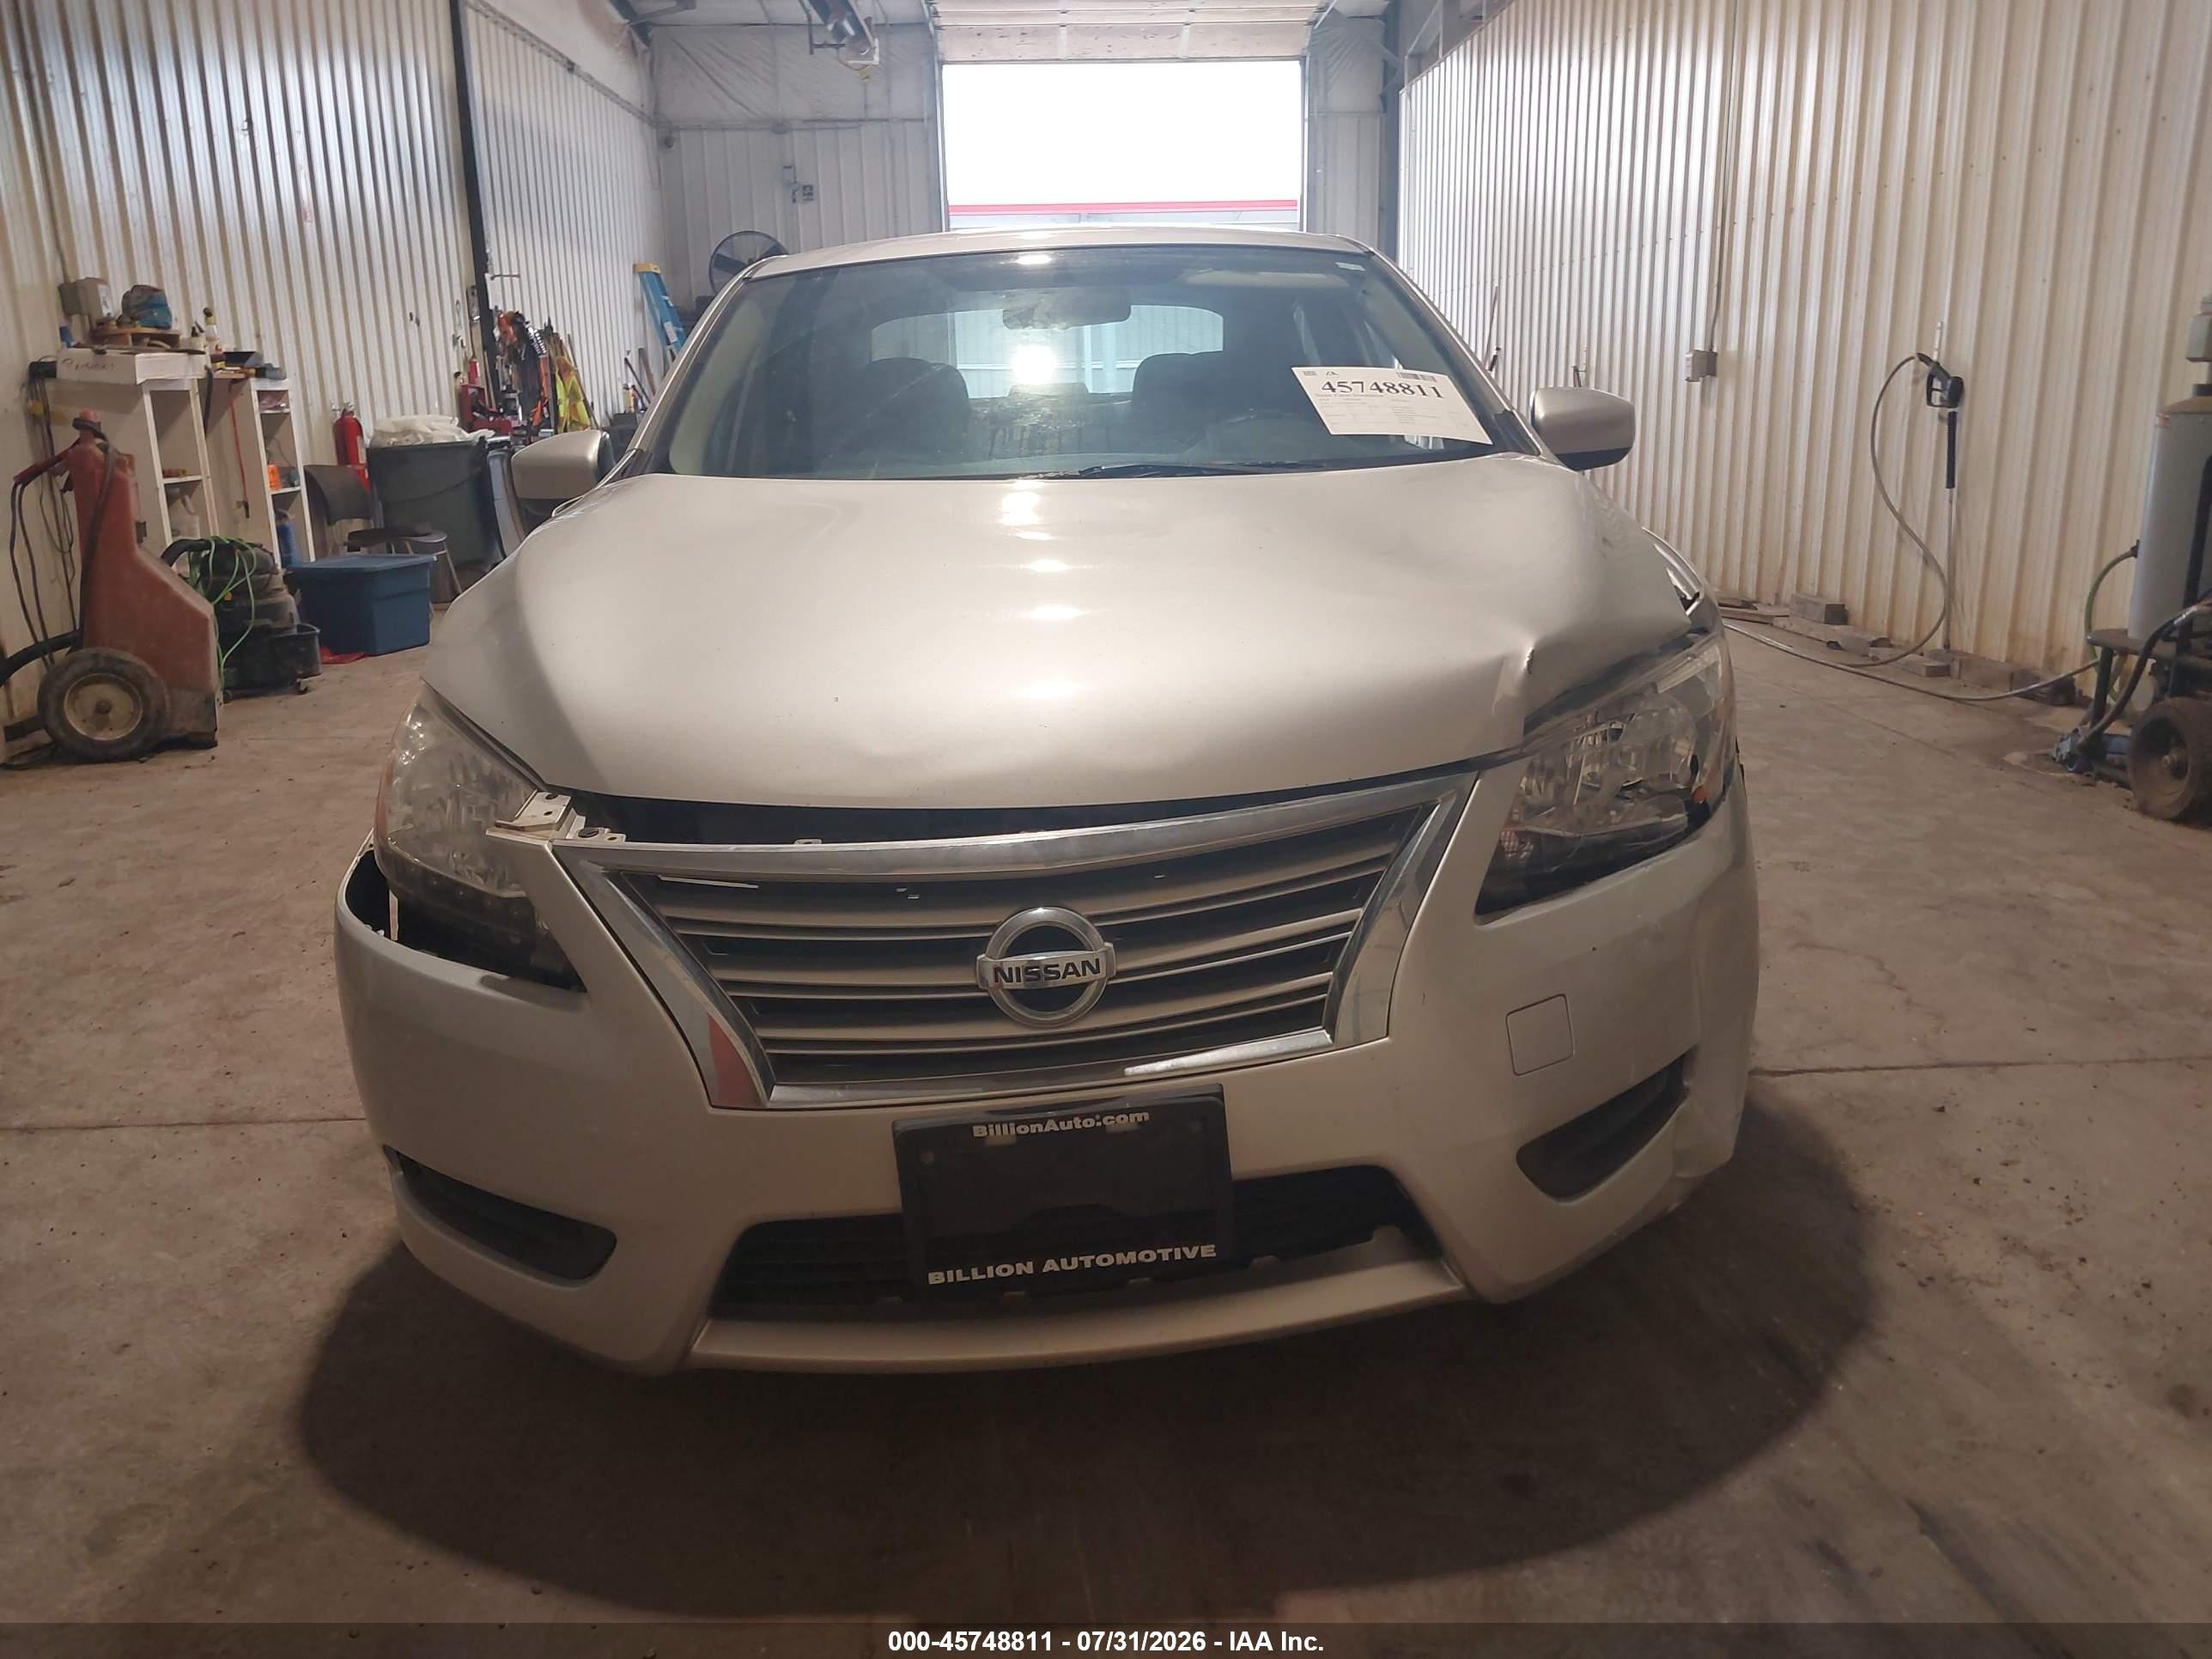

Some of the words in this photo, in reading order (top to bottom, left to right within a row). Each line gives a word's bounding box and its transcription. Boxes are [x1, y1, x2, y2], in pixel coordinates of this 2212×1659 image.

[1322, 380, 1445, 398] 45748811
[994, 957, 1101, 983] NISSAN
[972, 1111, 1150, 1138] BillionAuto.com
[928, 1261, 1034, 1285] BILLION
[1042, 1244, 1217, 1273] AUTOMOTIVE
